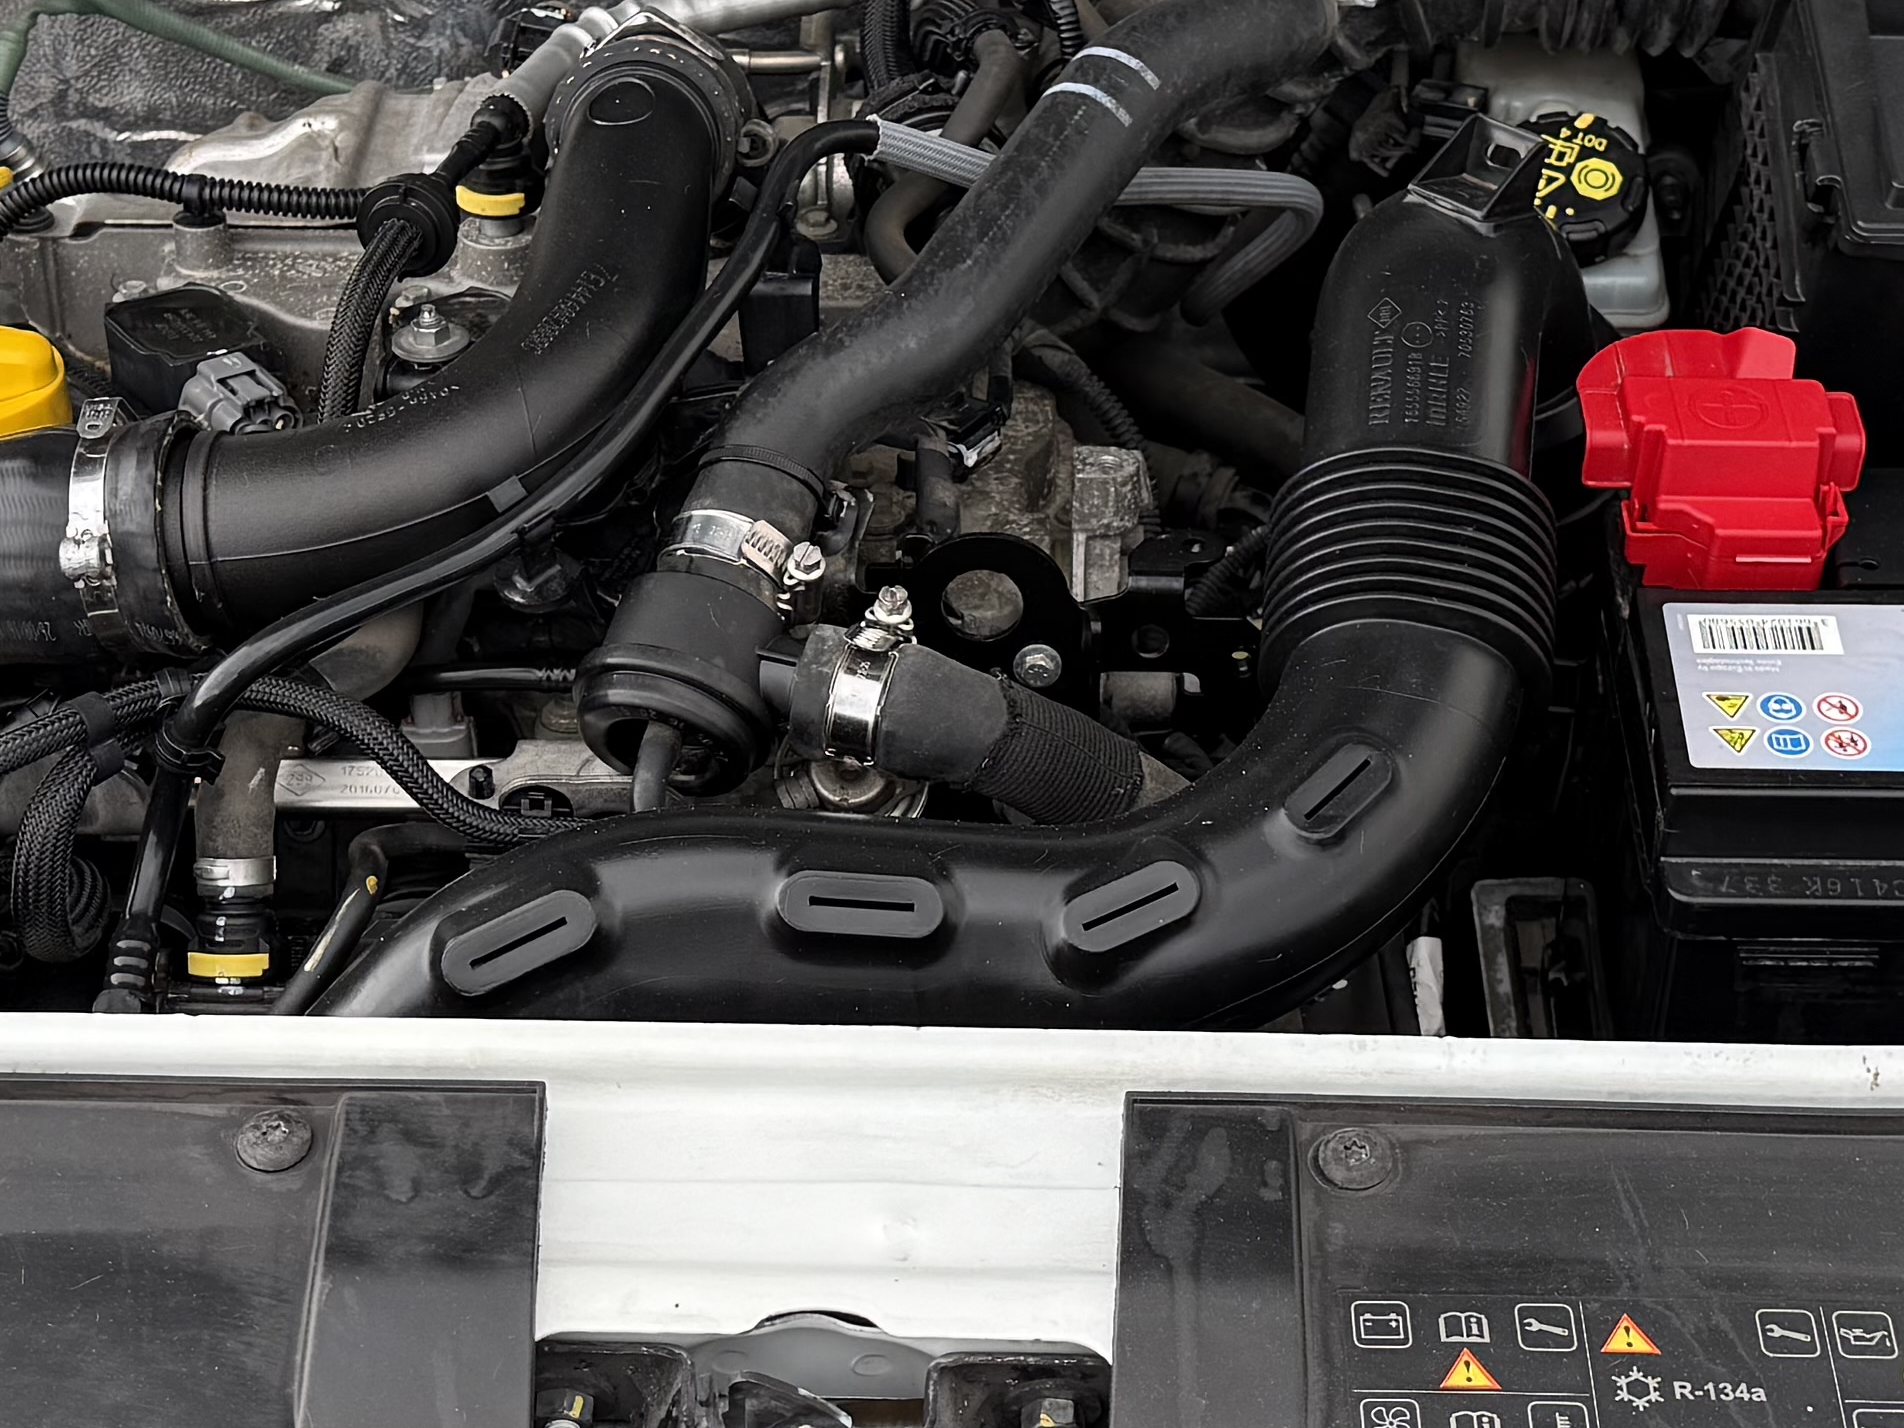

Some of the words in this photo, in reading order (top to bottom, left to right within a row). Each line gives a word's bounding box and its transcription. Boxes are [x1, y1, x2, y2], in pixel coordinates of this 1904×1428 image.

[1559, 127, 1572, 139] 4
[1572, 131, 1608, 152] DOT
[1368, 331, 1394, 426] RENAULT
[1673, 1380, 1768, 1403] R-134a
